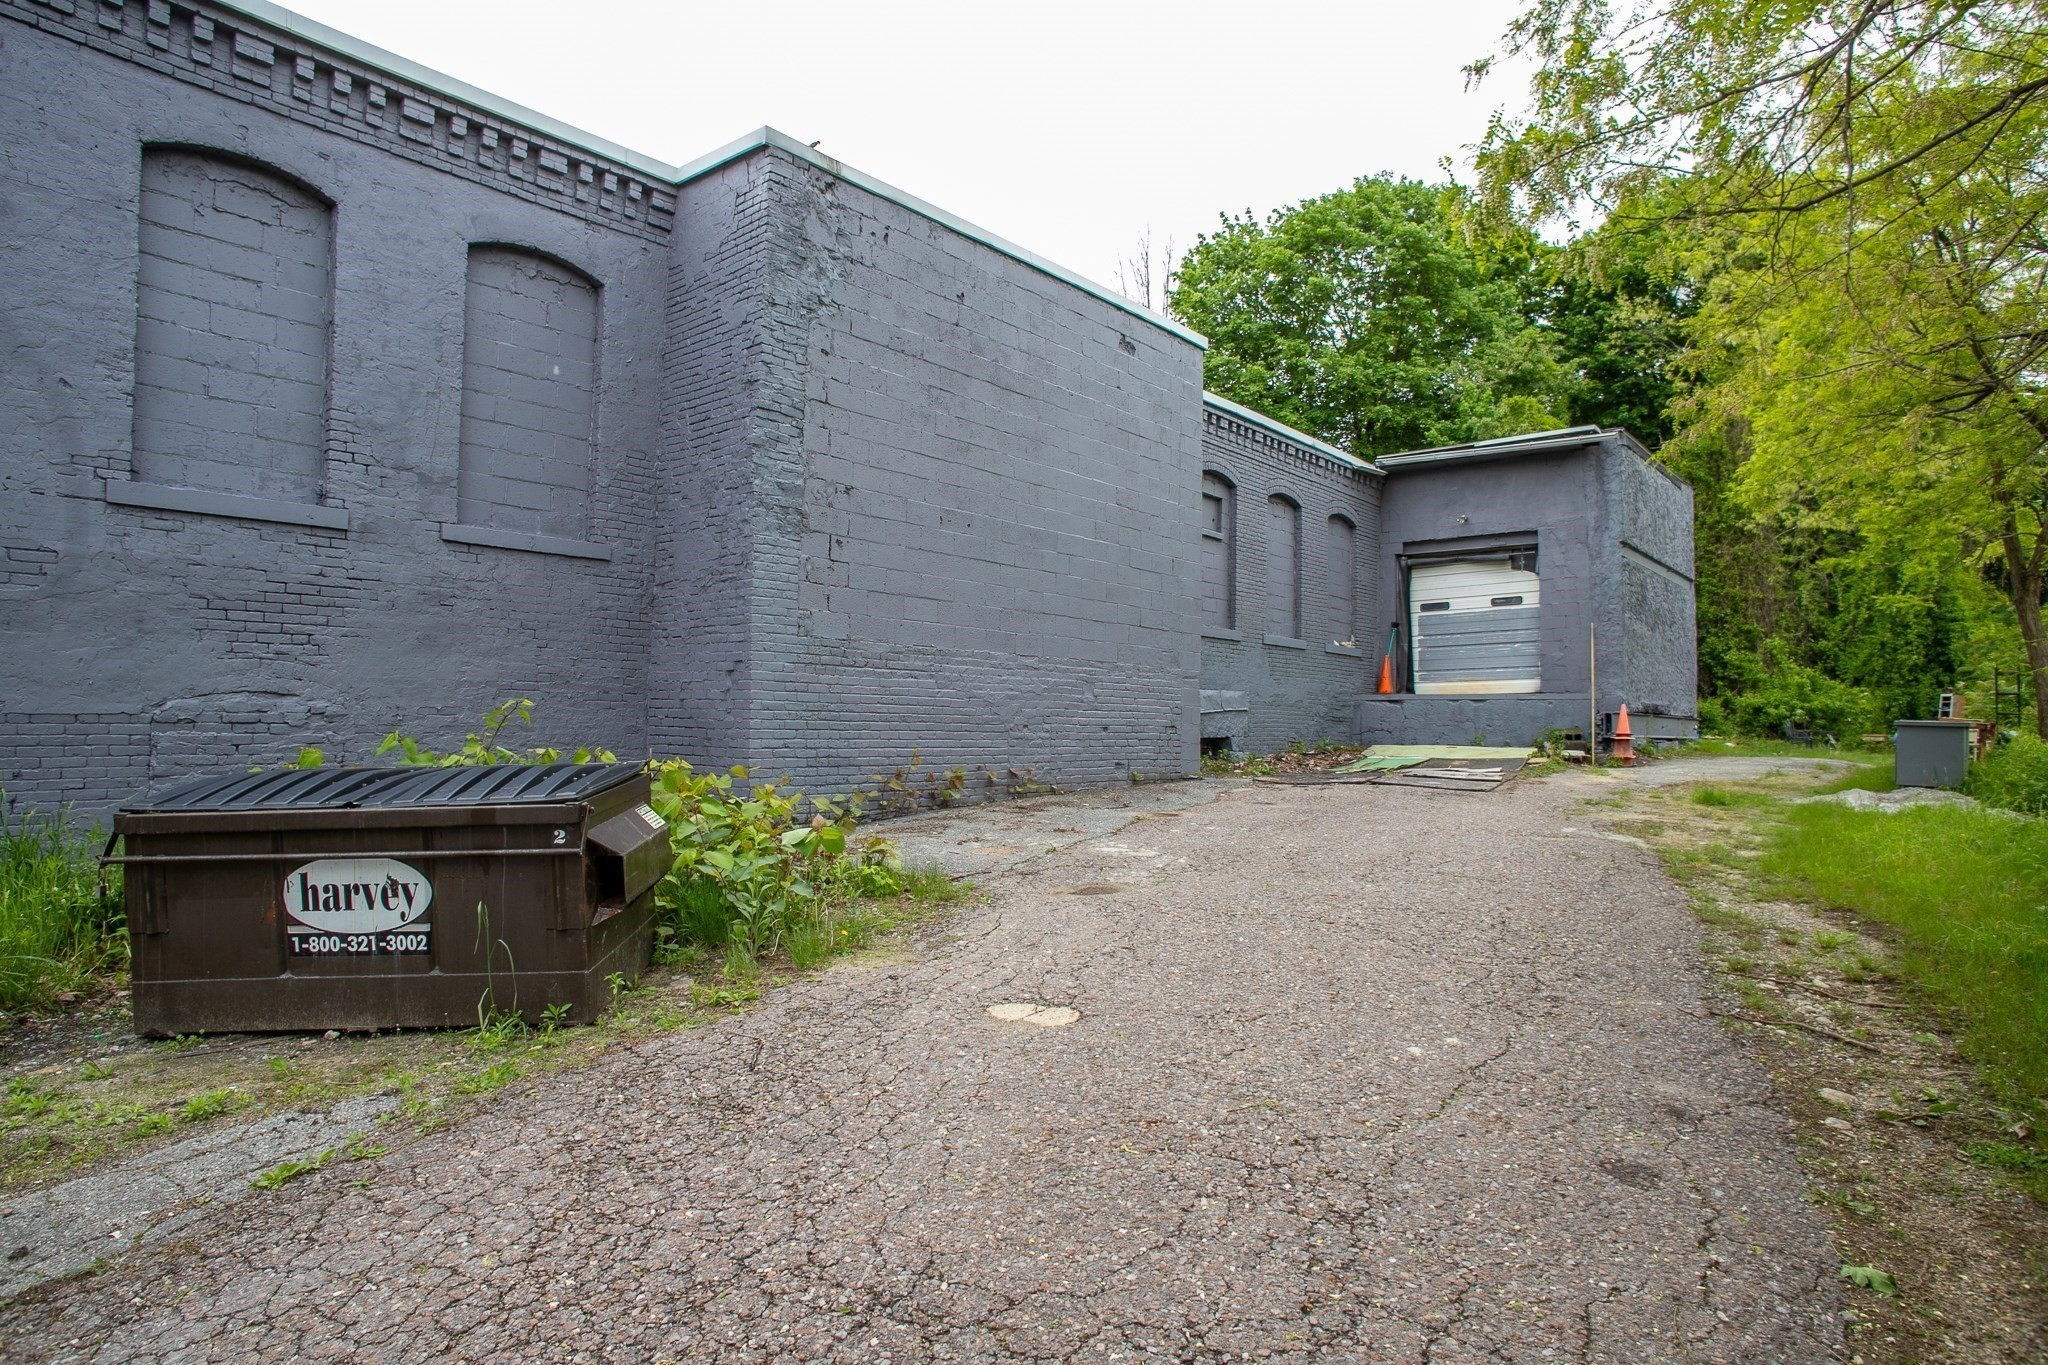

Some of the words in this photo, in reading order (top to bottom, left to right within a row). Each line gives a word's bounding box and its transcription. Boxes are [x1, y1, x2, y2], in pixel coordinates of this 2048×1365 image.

[553, 829, 566, 844] 2
[298, 872, 419, 922] harvey
[291, 934, 428, 953] 1-800-321-3002
